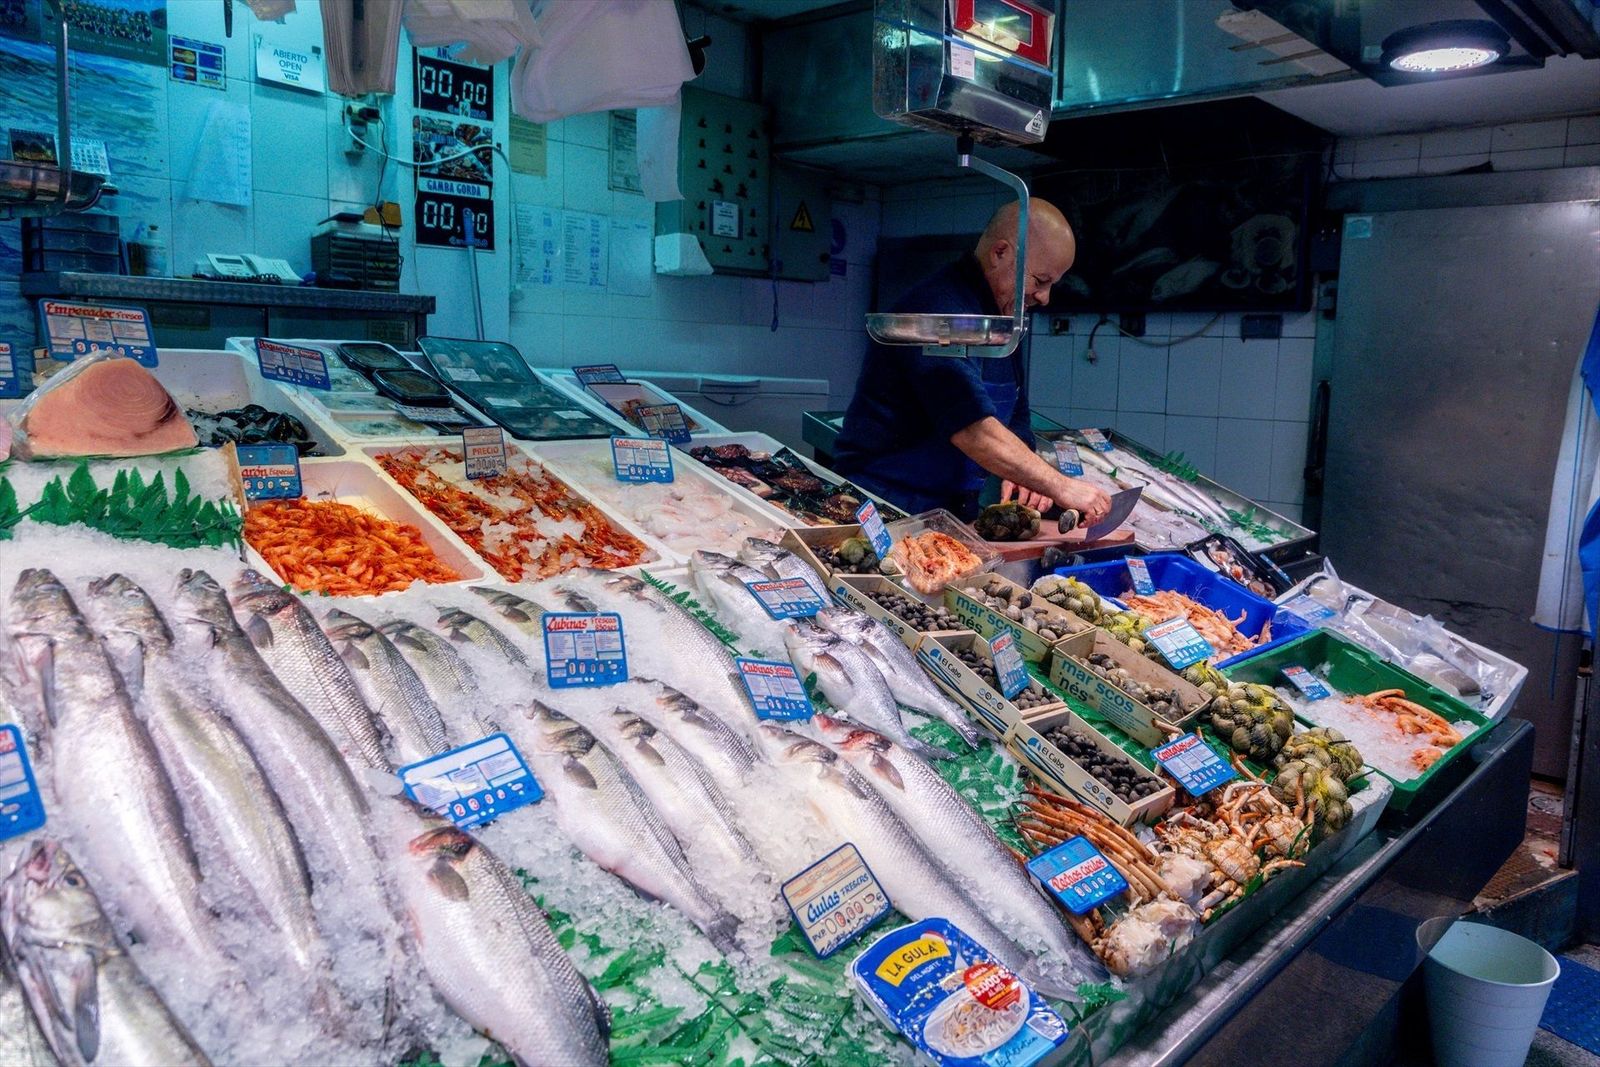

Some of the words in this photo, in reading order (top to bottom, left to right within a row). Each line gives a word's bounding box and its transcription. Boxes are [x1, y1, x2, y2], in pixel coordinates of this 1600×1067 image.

[273, 48, 308, 64] ABIERTO
[278, 59, 302, 72] OPEN
[284, 72, 300, 82] VISA
[427, 181, 455, 193] GAMBA
[456, 184, 482, 197] GORDA
[472, 446, 499, 456] PRECIO
[946, 661, 962, 679] Cabo
[1040, 746, 1049, 756] El
[1047, 752, 1066, 770] Cabo
[807, 891, 841, 923] Gulas
[886, 962, 905, 977] LA
[902, 943, 938, 963] GULA
